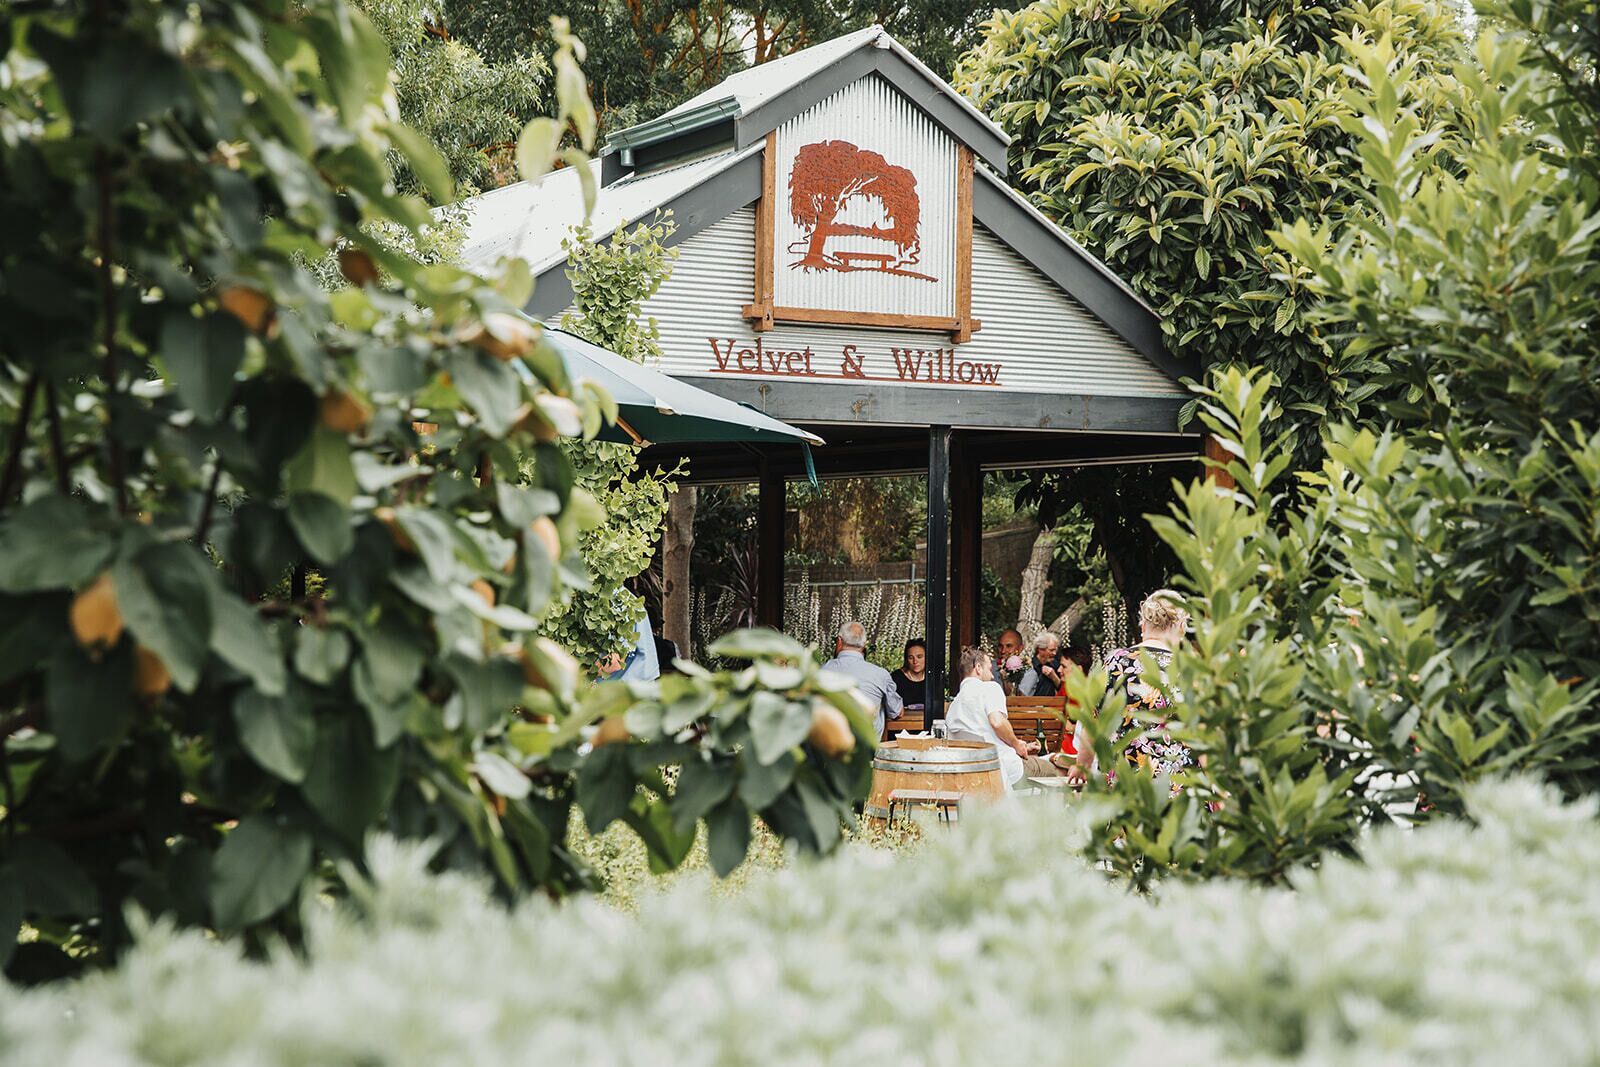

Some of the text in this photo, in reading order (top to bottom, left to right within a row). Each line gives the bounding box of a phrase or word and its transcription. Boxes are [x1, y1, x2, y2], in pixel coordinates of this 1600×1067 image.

[706, 337, 1003, 384] Velvet & Willow
